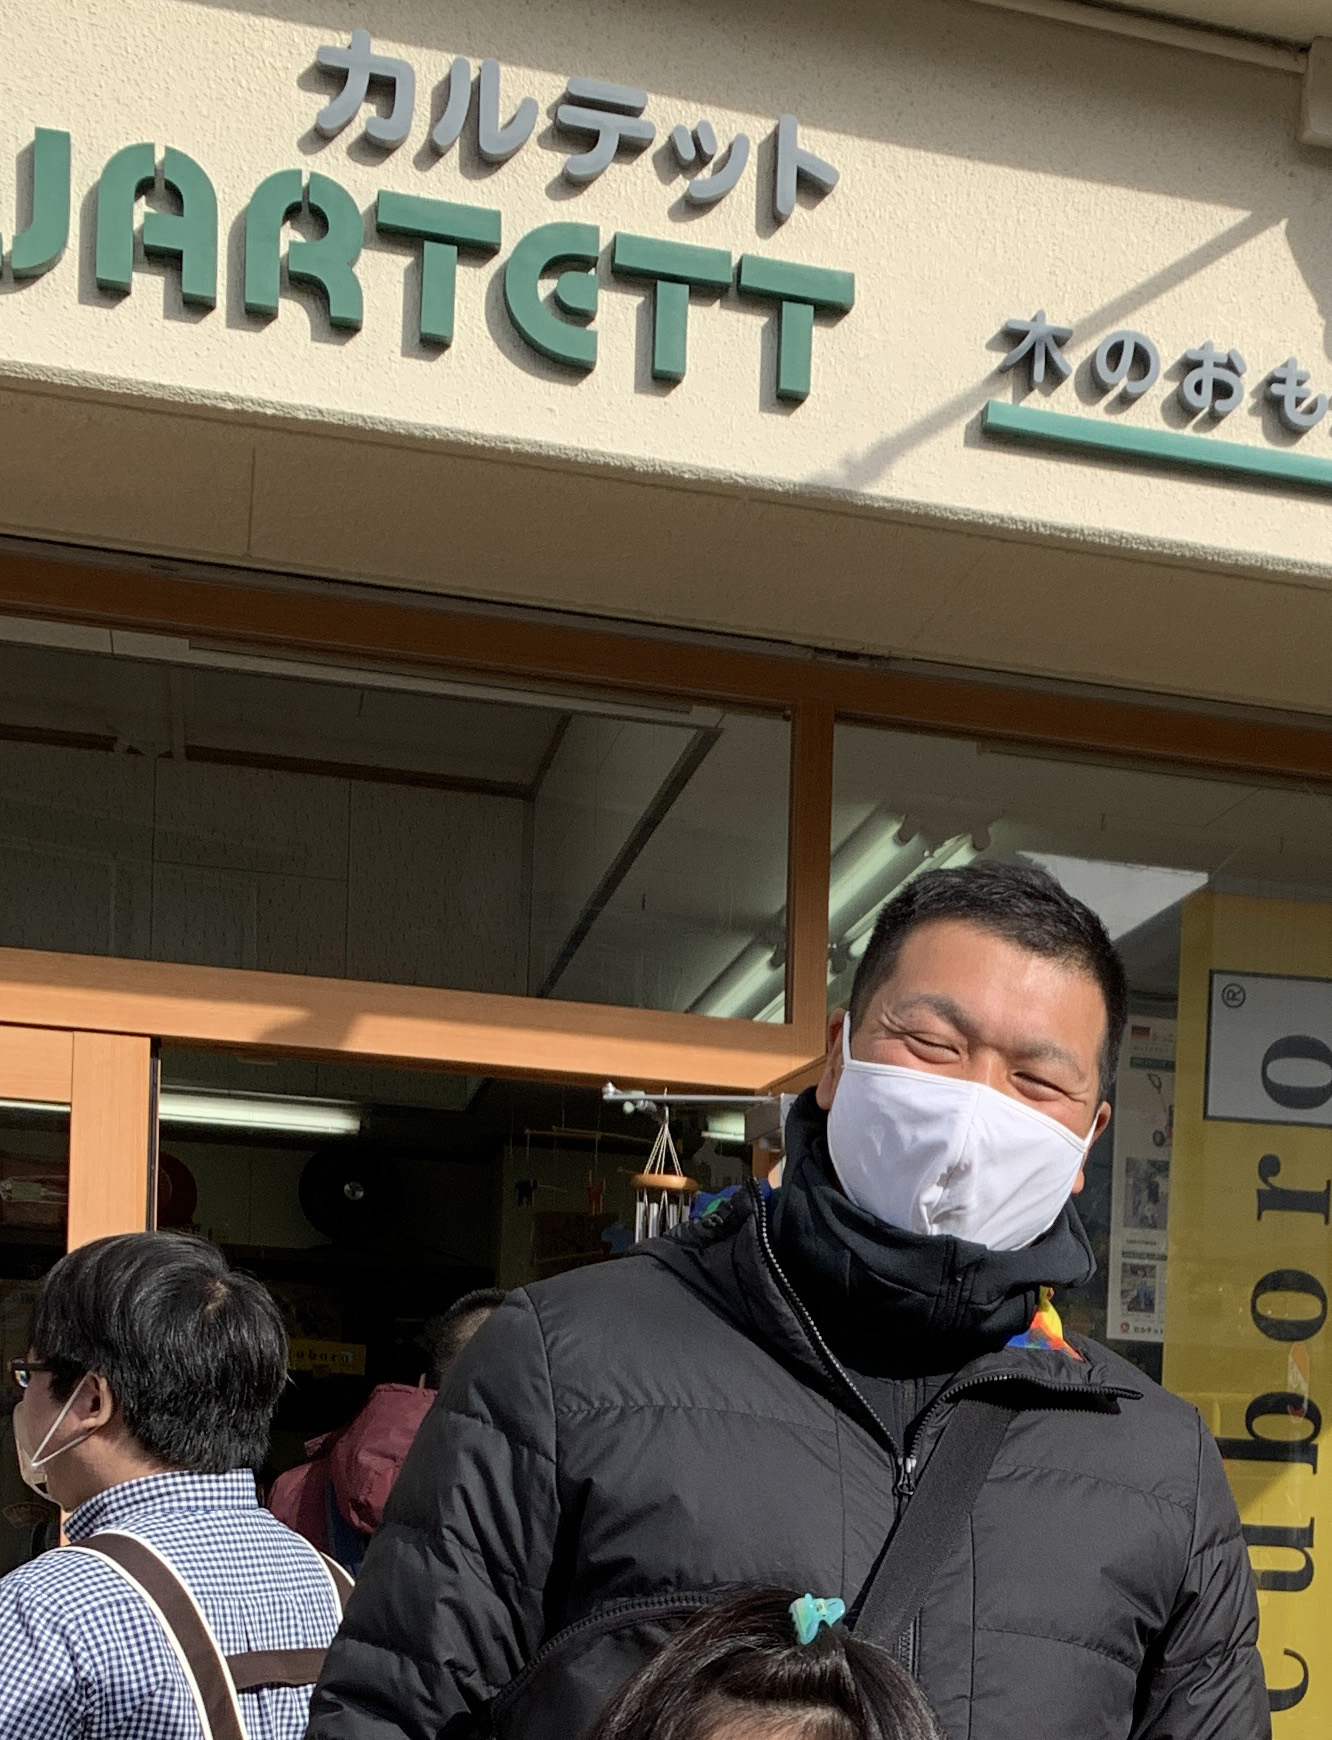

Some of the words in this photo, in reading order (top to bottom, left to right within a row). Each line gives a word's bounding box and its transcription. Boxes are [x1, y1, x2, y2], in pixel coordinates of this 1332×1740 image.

[315, 29, 840, 222] カルテット
